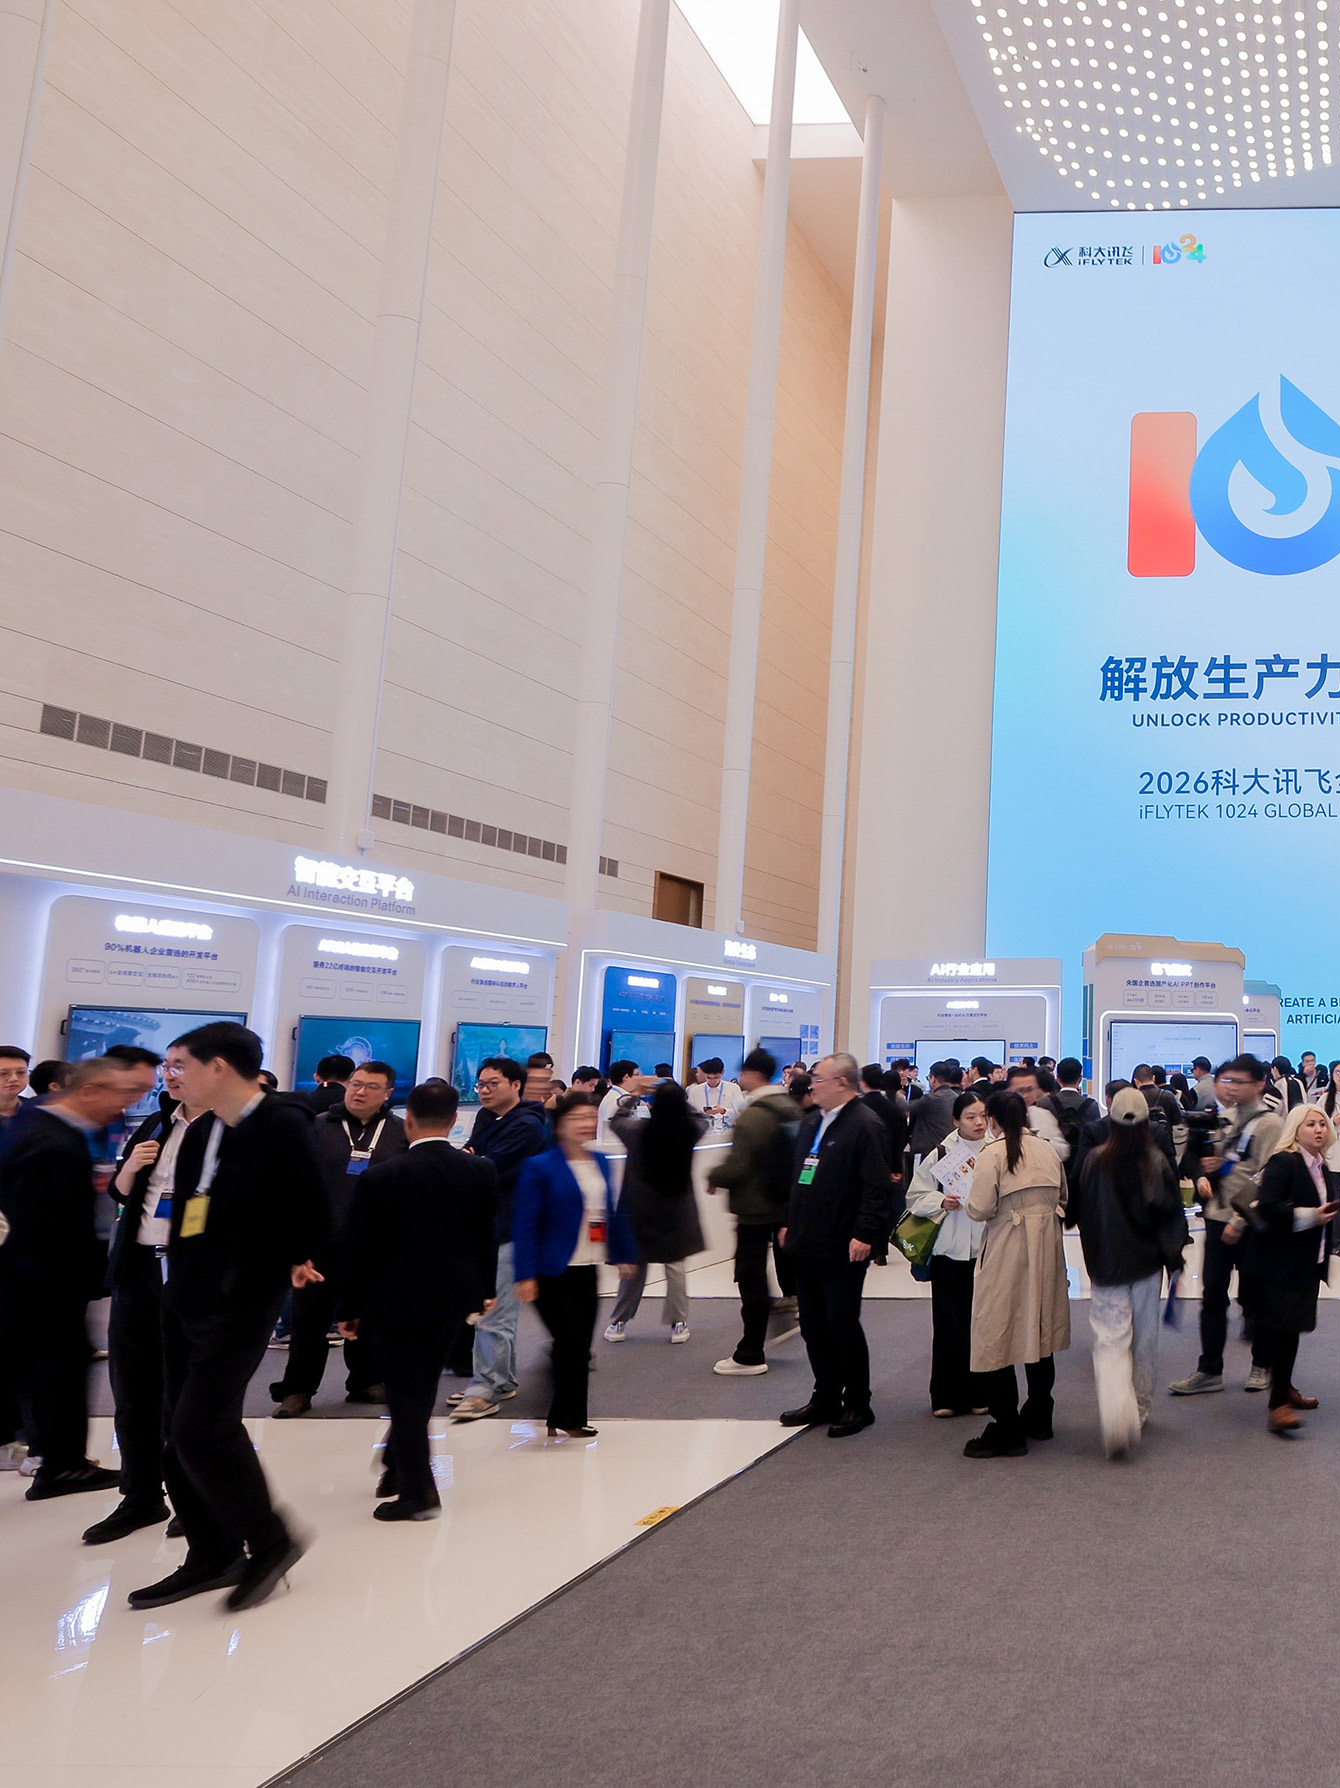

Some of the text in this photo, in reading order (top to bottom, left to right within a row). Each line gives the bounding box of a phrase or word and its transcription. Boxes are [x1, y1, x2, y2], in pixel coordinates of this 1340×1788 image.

[1078, 245, 1134, 258] 科大讯飞
[1078, 258, 1132, 266] iFLYTEK
[1132, 712, 1211, 728] UNLOCK
[1138, 803, 1210, 820] iFLYTEK
[1215, 803, 1259, 819] 1024
[1264, 802, 1338, 819] GLOBAL
[286, 884, 416, 915] AI Interaction Platform
[1279, 997, 1315, 1008] REATE
[1317, 997, 1327, 1008] A
